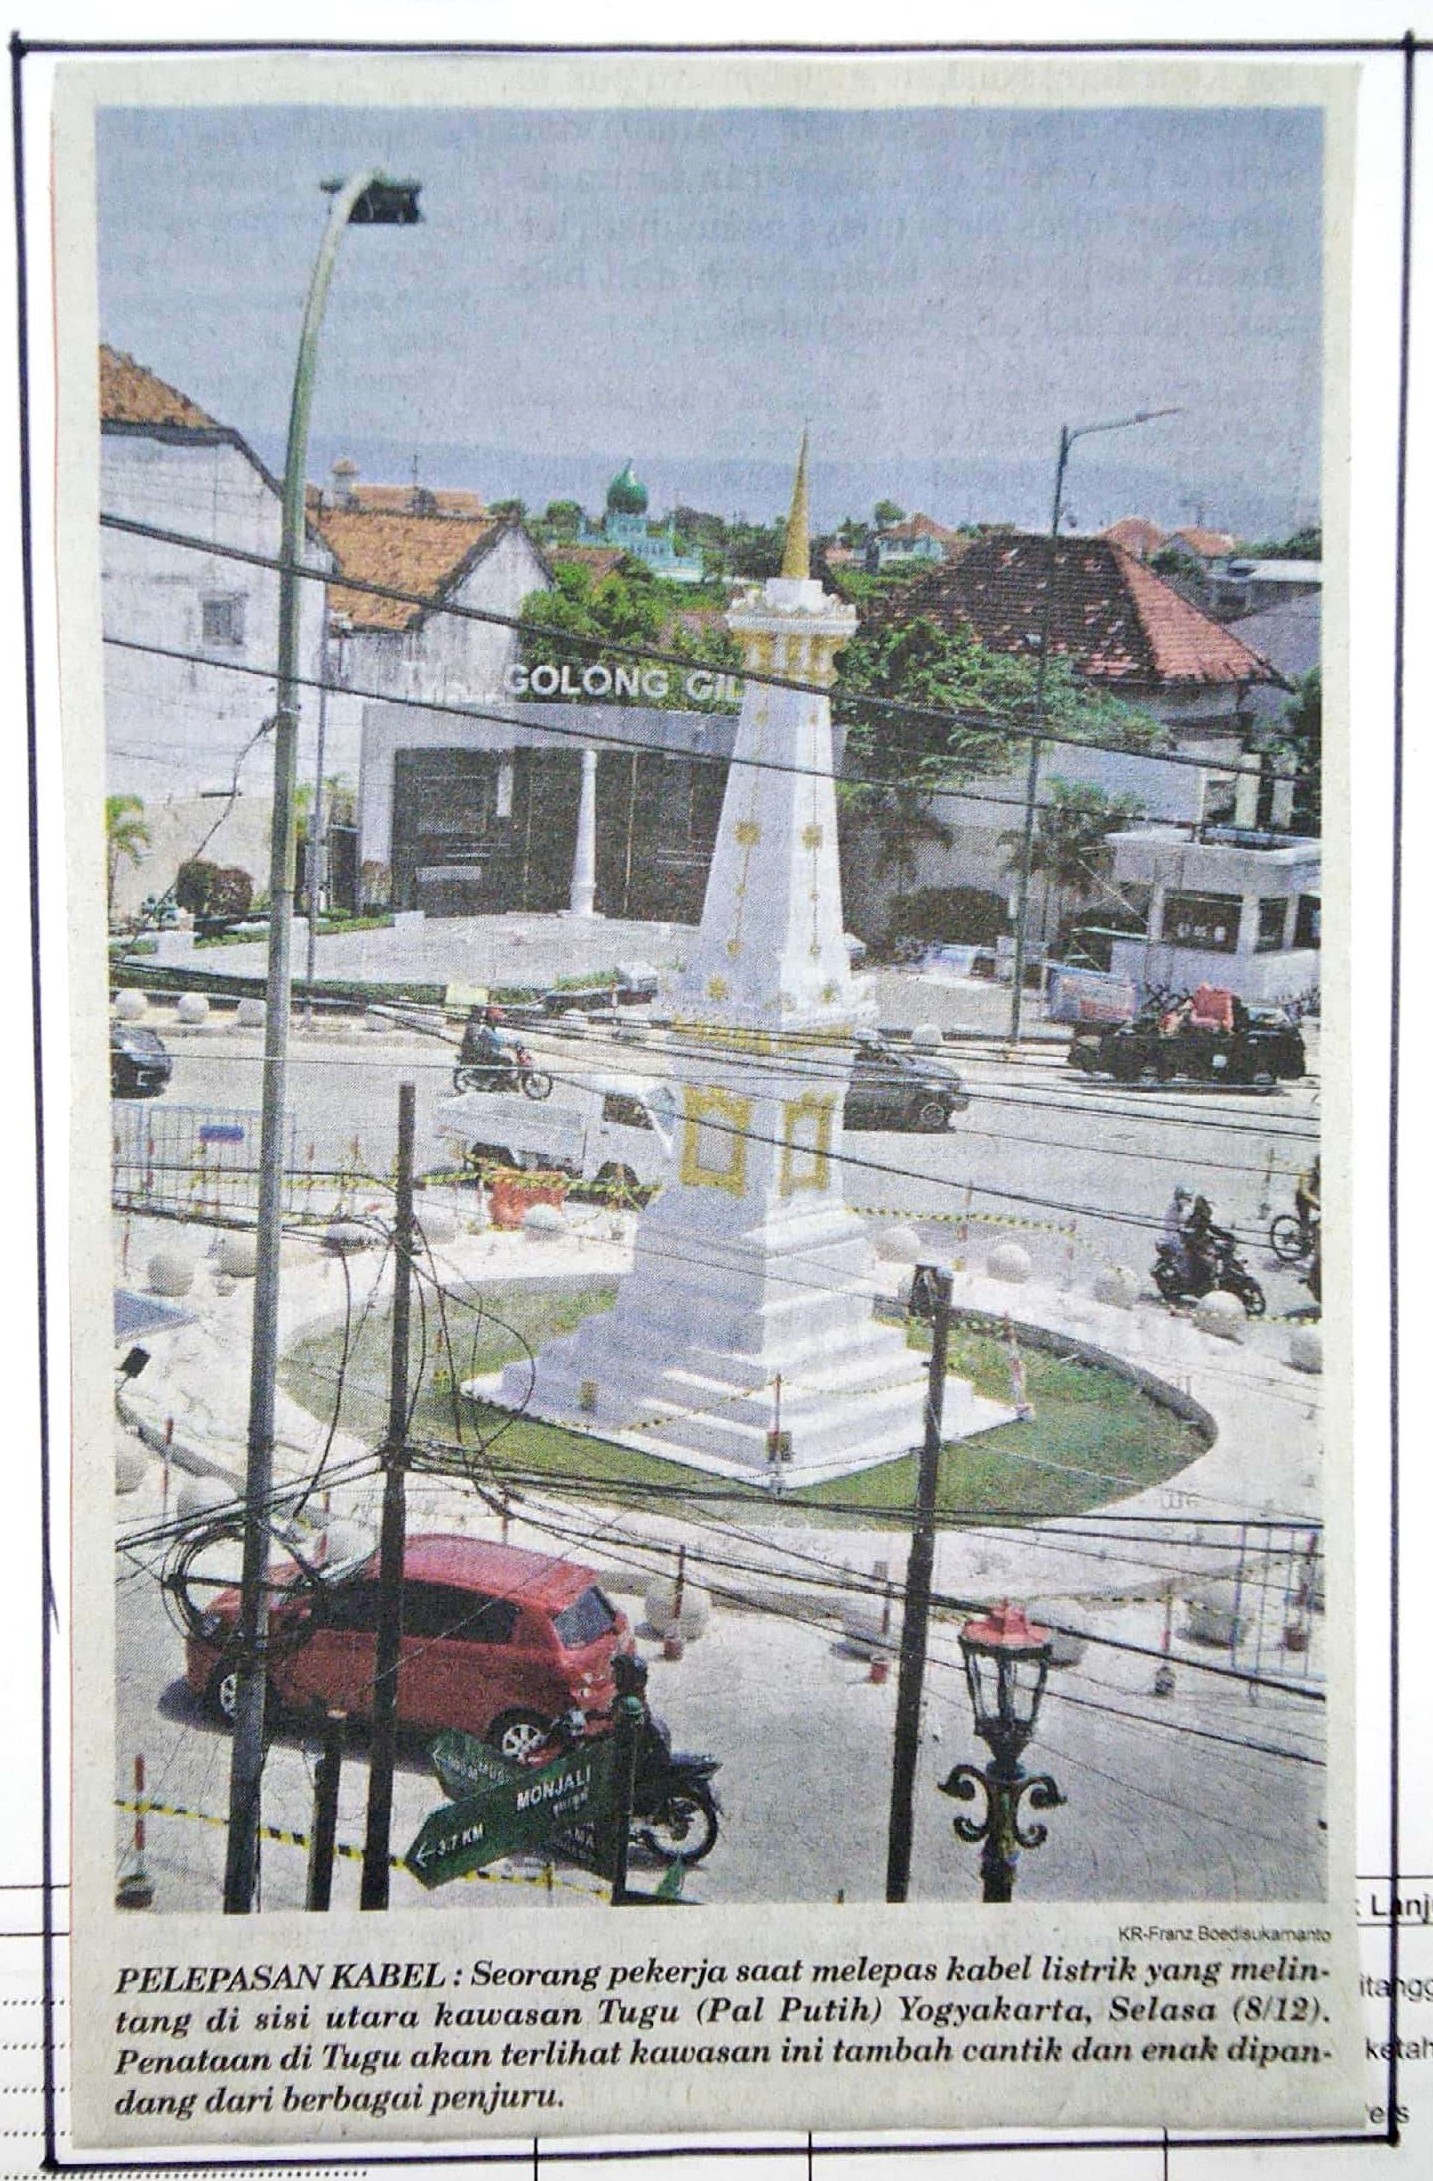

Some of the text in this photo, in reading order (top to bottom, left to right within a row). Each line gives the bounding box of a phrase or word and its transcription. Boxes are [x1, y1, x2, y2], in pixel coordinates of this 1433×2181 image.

[505, 664, 670, 699] GOLONG
[516, 1765, 592, 1811] MONJALI
[1118, 1925, 1194, 1942] KR-Franz
[113, 1963, 325, 1990] PELEPASAN
[328, 1961, 446, 1991] KABEL
[470, 1959, 602, 1992] Seorang
[605, 1958, 729, 1992] pekerja
[735, 1959, 804, 1983] saat
[811, 1956, 938, 1989] melepas
[945, 1955, 1032, 1982] kabel
[1041, 1954, 1137, 1983] listrik
[1143, 1961, 1223, 1988] yang
[1230, 1955, 1331, 1982] melin-
[115, 1994, 1330, 2039] tang di sisi utara kawasan Tugu (Pal Putih) Yogyakarta, Selasa (8/12).
[113, 2034, 1333, 2076] Penataan di Tugu akan terlihat kawasan ini tambah cantik dan enak dipan-
[114, 2081, 564, 2121] dang dari berbagai penjuru.
